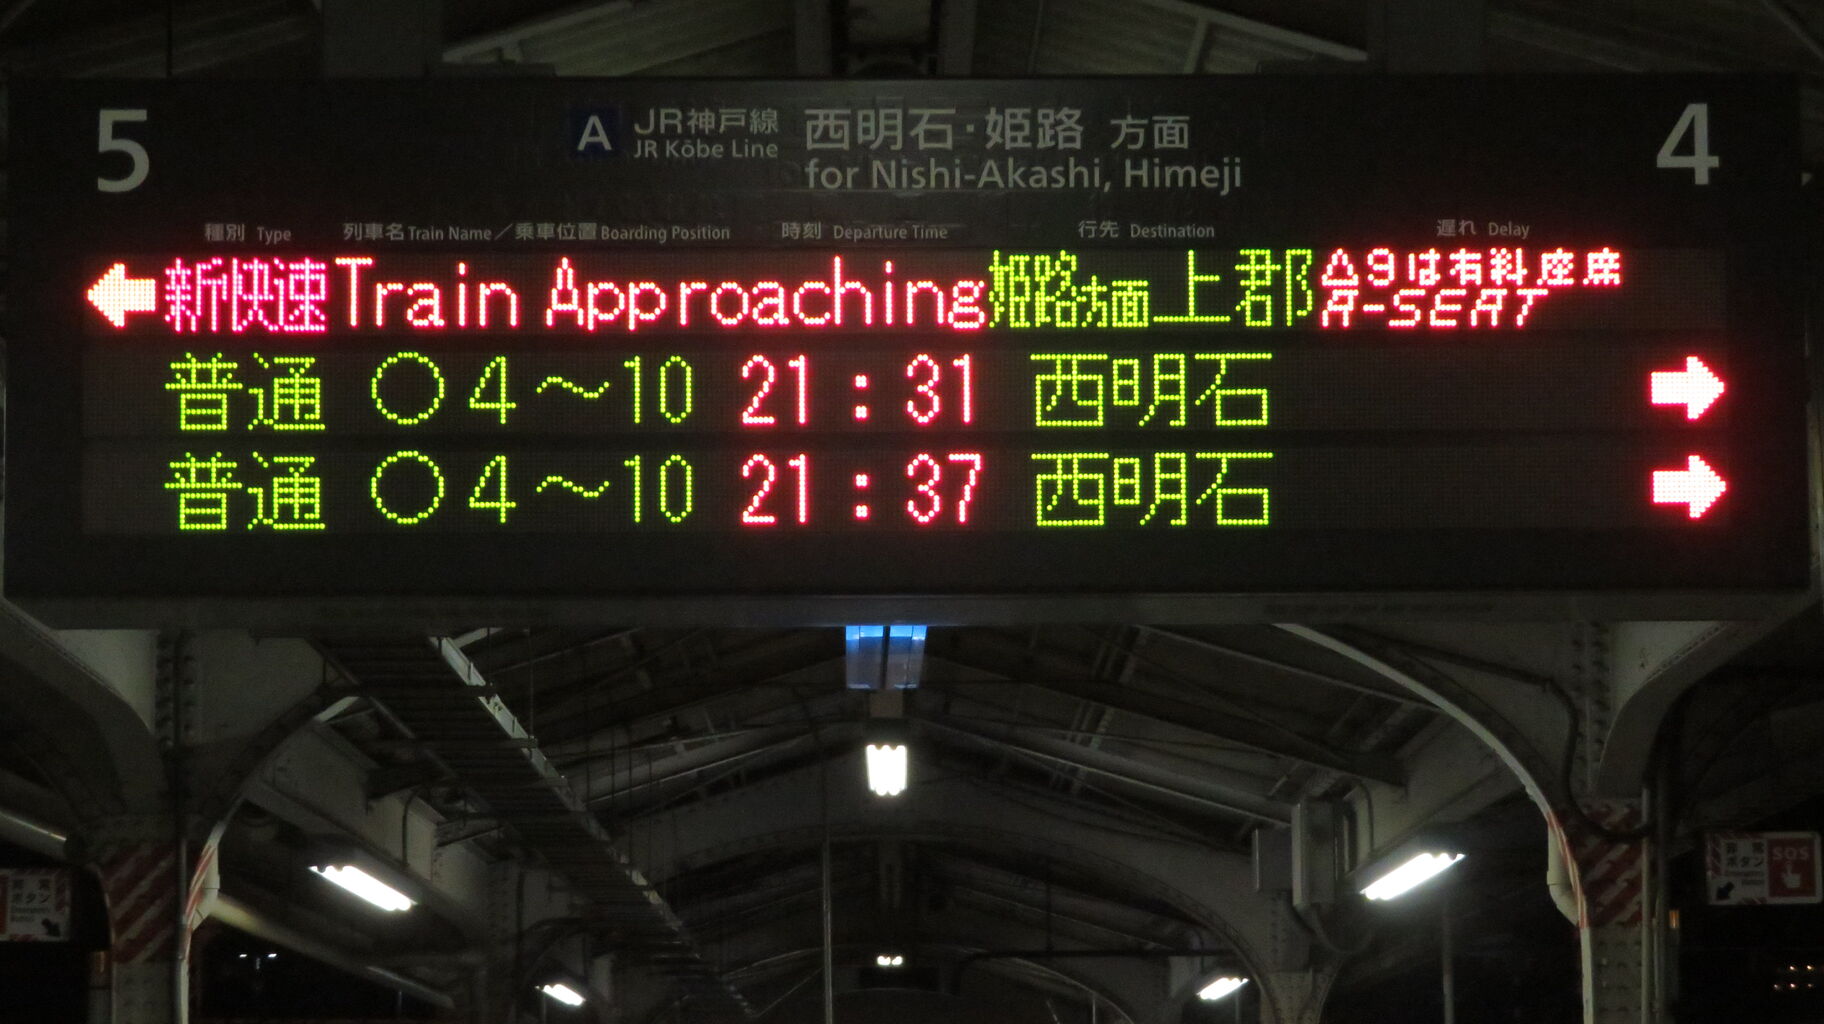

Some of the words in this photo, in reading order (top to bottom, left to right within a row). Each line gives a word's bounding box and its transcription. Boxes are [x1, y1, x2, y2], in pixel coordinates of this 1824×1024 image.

[578, 116, 611, 150] A
[635, 108, 778, 134] JR神戸線
[1111, 115, 1189, 149] 方面
[98, 110, 149, 192] 5
[635, 140, 657, 158] JR
[732, 139, 778, 157] Line
[1657, 103, 1719, 185] 4
[805, 158, 859, 189] for
[872, 157, 1110, 194] Nishi-Akashi,
[1125, 158, 1240, 195] Himeji
[205, 224, 244, 241] 種別
[257, 227, 291, 245] Type
[344, 223, 404, 241] 列車名
[408, 227, 443, 240] Train
[602, 225, 666, 243] Boarding
[672, 225, 729, 239] Position
[782, 222, 821, 239] 時刻
[834, 225, 907, 242] Departure
[913, 225, 947, 238] Time
[1079, 221, 1118, 238] 行先
[1131, 224, 1214, 238] Destination
[1437, 220, 1476, 240] 遅れ
[1488, 221, 1530, 240] Delay
[163, 256, 327, 333] 新快速
[334, 256, 521, 330] Train
[544, 255, 987, 332] Approaching
[988, 250, 1149, 328] 姫路方面
[1153, 249, 1312, 326] 上郡
[1321, 288, 1550, 329] A-SEAT
[165, 353, 325, 430] 普通
[1030, 353, 1272, 426] 西明石
[165, 452, 325, 530] 普通
[1031, 452, 1273, 526] 西明石
[1773, 846, 1810, 860] SOS
